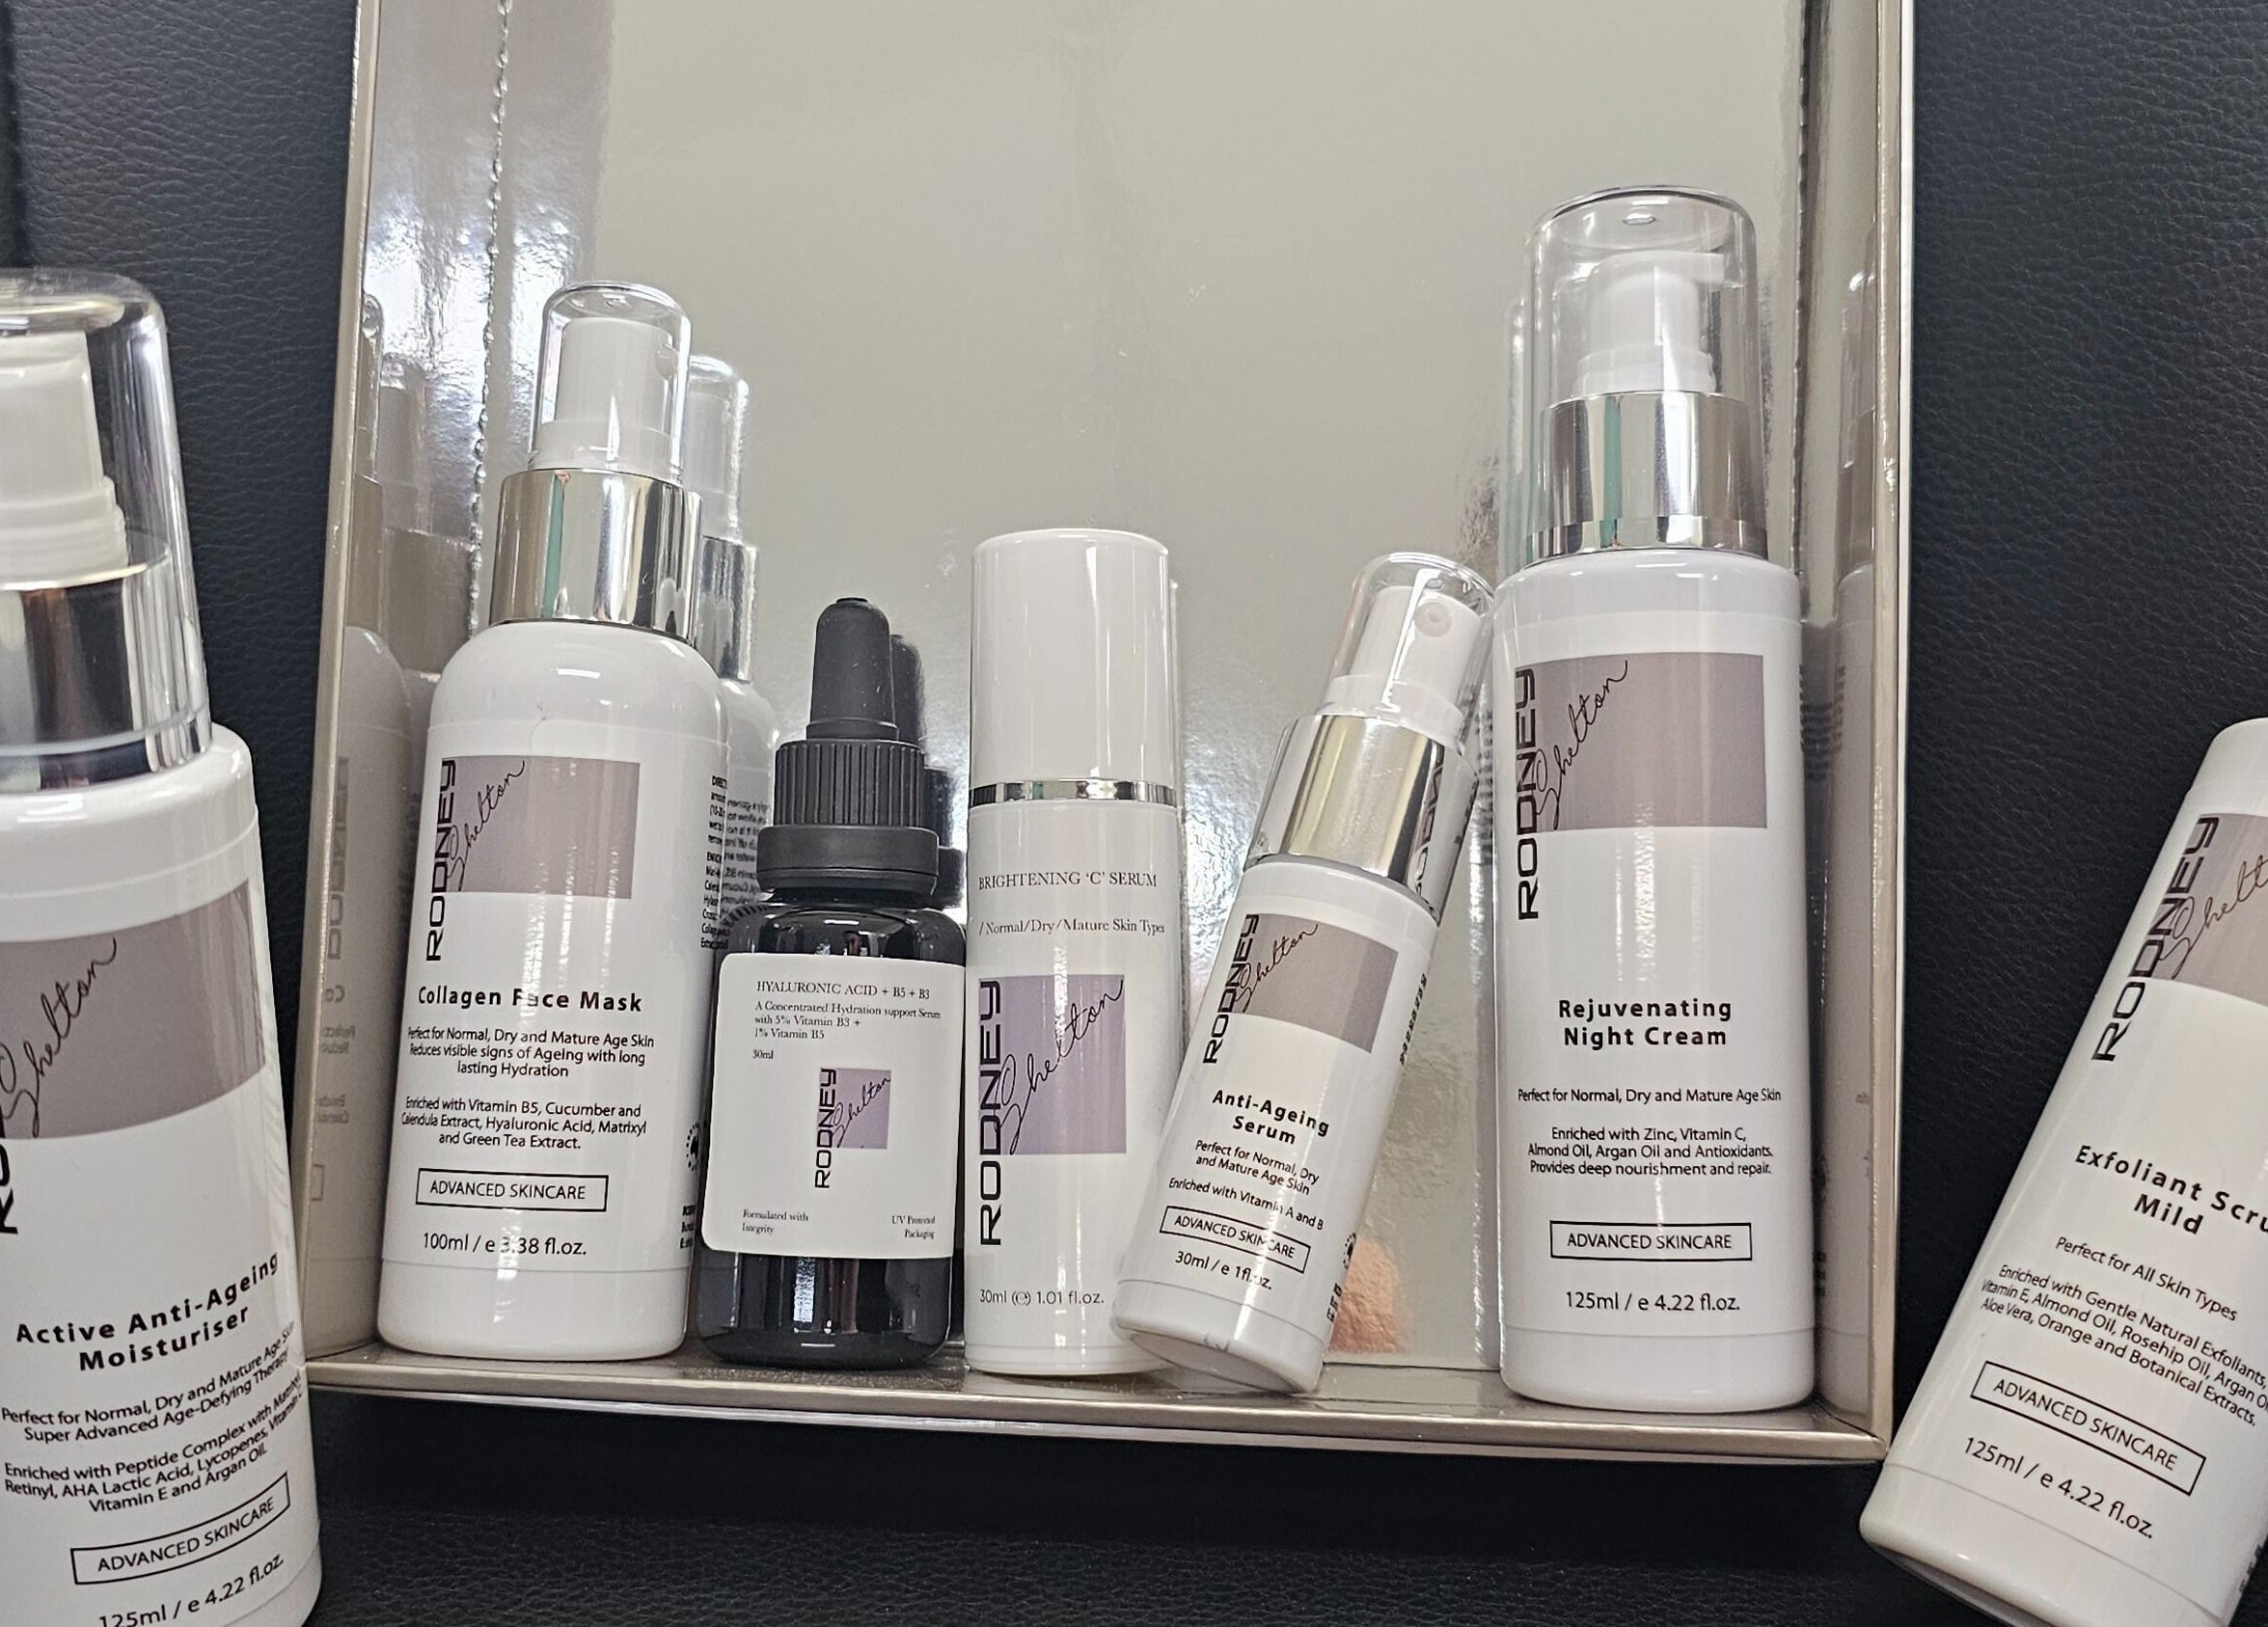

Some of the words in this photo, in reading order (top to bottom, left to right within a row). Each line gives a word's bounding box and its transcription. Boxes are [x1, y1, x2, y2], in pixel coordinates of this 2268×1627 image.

[1516, 667, 1538, 920] RODNEY
[426, 759, 456, 962] RODNEY
[979, 872, 1080, 890] BRIGHTENING
[1108, 872, 1158, 887] SERUM
[1112, 919, 1136, 932] Skin
[2091, 817, 2220, 1061] RODNEY
[419, 986, 502, 1009] Collagen
[512, 989, 569, 1009] Face
[580, 991, 642, 1012] Mask
[756, 981, 841, 995] HYALURONIC
[844, 983, 877, 996] ACID
[892, 987, 906, 997] B5
[919, 988, 929, 999] B3
[1203, 914, 1259, 1064] RODNEY
[765, 1002, 828, 1013] Concentrated
[832, 1003, 881, 1016] Hydration
[794, 1016, 833, 1027] Vitamin
[836, 1017, 850, 1027] B3
[1559, 998, 1733, 1022] Rejuvenating
[447, 1028, 491, 1044] Normal,
[494, 1029, 518, 1044] Dry
[552, 1032, 600, 1045] Mature
[631, 1035, 654, 1047] Skin
[771, 1028, 807, 1039] Vitamin
[811, 1030, 825, 1040] B5
[1564, 1026, 1634, 1051] Night
[1645, 1028, 1727, 1046] Cream
[444, 1044, 478, 1057] visible
[481, 1045, 513, 1061] signs
[535, 1048, 583, 1065] Ageing
[587, 1049, 615, 1062] with
[619, 1050, 645, 1066] long
[752, 1049, 774, 1060] 30ml
[457, 1061, 497, 1077] lasting
[501, 1064, 569, 1079] Hydration
[442, 1098, 466, 1111] with
[469, 1099, 517, 1113] Vitamin
[522, 1101, 541, 1116] B5,
[546, 1102, 615, 1117] Cucumber
[1518, 1089, 1550, 1102] Perfect
[1552, 1089, 1568, 1101] for
[1571, 1089, 1623, 1103] Normal,
[1626, 1090, 1651, 1104] Dry
[1654, 1089, 1681, 1102] and
[1686, 1089, 1733, 1102] Mature
[1736, 1089, 1759, 1104] Age
[1762, 1089, 1782, 1101] Skin
[441, 1115, 482, 1130] Extract,
[486, 1117, 559, 1134] Hyaluronic
[562, 1119, 595, 1134] Acid,
[599, 1121, 647, 1136] Matrixyl
[979, 980, 1000, 1246] RODNEY
[1213, 1090, 1329, 1137] Anti-Ageing
[463, 1133, 500, 1146] Green
[504, 1134, 525, 1147] Tea
[530, 1135, 581, 1149] Extract.
[815, 1069, 836, 1188] RODNEY
[1233, 1116, 1297, 1145] Serum
[1552, 1127, 1604, 1141] Enriched
[1609, 1128, 1640, 1141] with
[1644, 1128, 1677, 1143] Zinc,
[1681, 1128, 1732, 1141] Vitamin
[1195, 1140, 1232, 1157] Perfect
[1253, 1151, 1298, 1176] Normal,
[1299, 1165, 1320, 1184] Dry
[1528, 1143, 1569, 1156] Almond
[1572, 1145, 1592, 1158] Oil,
[1596, 1146, 1637, 1161] Argan
[1641, 1145, 1660, 1158] Oil
[1664, 1145, 1690, 1158] and
[1217, 1159, 1258, 1180] Mature
[1261, 1172, 1285, 1190] Age
[1287, 1178, 1310, 1195] Skin
[1530, 1161, 1574, 1174] Provides
[1578, 1161, 1611, 1177] deep
[1616, 1163, 1707, 1176] nourishment
[1710, 1162, 1734, 1176] and
[1737, 1161, 1771, 1176] repair.
[430, 1180, 505, 1198] ADVANCED
[510, 1184, 586, 1200] SKINCARE
[1169, 1178, 1209, 1196] Enriched
[1212, 1186, 1238, 1201] with
[2075, 1145, 2203, 1202] Exfoliant
[2211, 1190, 2268, 1234] Scru
[1174, 1214, 1237, 1239] ADVANCED
[2134, 1194, 2204, 1234] Mild
[424, 1233, 469, 1251] 100ml
[545, 1237, 587, 1255] fl.oz.
[1568, 1234, 1652, 1249] ADVANCED
[1656, 1234, 1732, 1250] SKINCARE
[1175, 1250, 1209, 1270] 30ml
[2056, 1236, 2106, 1264] Perfect
[2132, 1265, 2156, 1283] All
[2159, 1274, 2191, 1298] Skin
[2195, 1289, 2237, 1321] Types
[16, 1323, 115, 1343] Active
[129, 1253, 279, 1334] Anti-Ageing
[979, 1288, 1007, 1304] 30ml
[1037, 1290, 1062, 1305] 1.01
[1068, 1289, 1105, 1305] fl.oz.
[1567, 1291, 1618, 1310] 125ml
[1655, 1294, 1694, 1311] 4.22
[1701, 1293, 1740, 1312] fl.oz.
[80, 1306, 249, 1370] Moisturiser
[1999, 1264, 2049, 1288] Enriched
[2052, 1280, 2083, 1299] with
[2087, 1291, 2138, 1320] Gentle
[2141, 1313, 2200, 1347] Natural
[2201, 1342, 2267, 1390] Exfoliants,
[2033, 1295, 2090, 1322] Almond
[2092, 1315, 2117, 1336] Oil,
[2121, 1326, 2184, 1365] Rosehip
[2188, 1355, 2211, 1382] Oil,
[2214, 1370, 2255, 1405] Argan
[2007, 1304, 2035, 1324] Vera,
[2038, 1315, 2092, 1344] Orange
[2130, 1350, 2202, 1393] Botanical
[2203, 1387, 2256, 1426] Extracts.
[2, 1407, 54, 1424] Perfect
[85, 1402, 151, 1423] Normal,
[156, 1393, 183, 1414] Dry
[219, 1357, 262, 1386] Mature
[24, 1427, 70, 1444] Super
[75, 1416, 158, 1440] Advanced
[163, 1381, 252, 1426] Age-Defying
[1994, 1378, 2088, 1426] ADVANCED
[2090, 1418, 2178, 1472] SKINCARE
[5, 1462, 69, 1481] Enriched
[74, 1463, 110, 1479] with
[116, 1453, 178, 1477] Peptide
[183, 1424, 246, 1458] Complex
[5, 1481, 57, 1500] Retinyl,
[63, 1483, 96, 1497] AHA
[102, 1475, 151, 1495] Lactic
[156, 1464, 194, 1486] Acid,
[89, 1494, 153, 1512] Vitamin
[205, 1458, 246, 1486] Argan
[1964, 1437, 2024, 1474] 125ml
[2058, 1478, 2105, 1512] 4.22
[2108, 1502, 2153, 1539] fl.oz.
[97, 1538, 200, 1572] ADVANCED
[204, 1497, 274, 1545] SKINCARE
[99, 1604, 166, 1627] 125ml
[205, 1577, 245, 1606] 4.22
